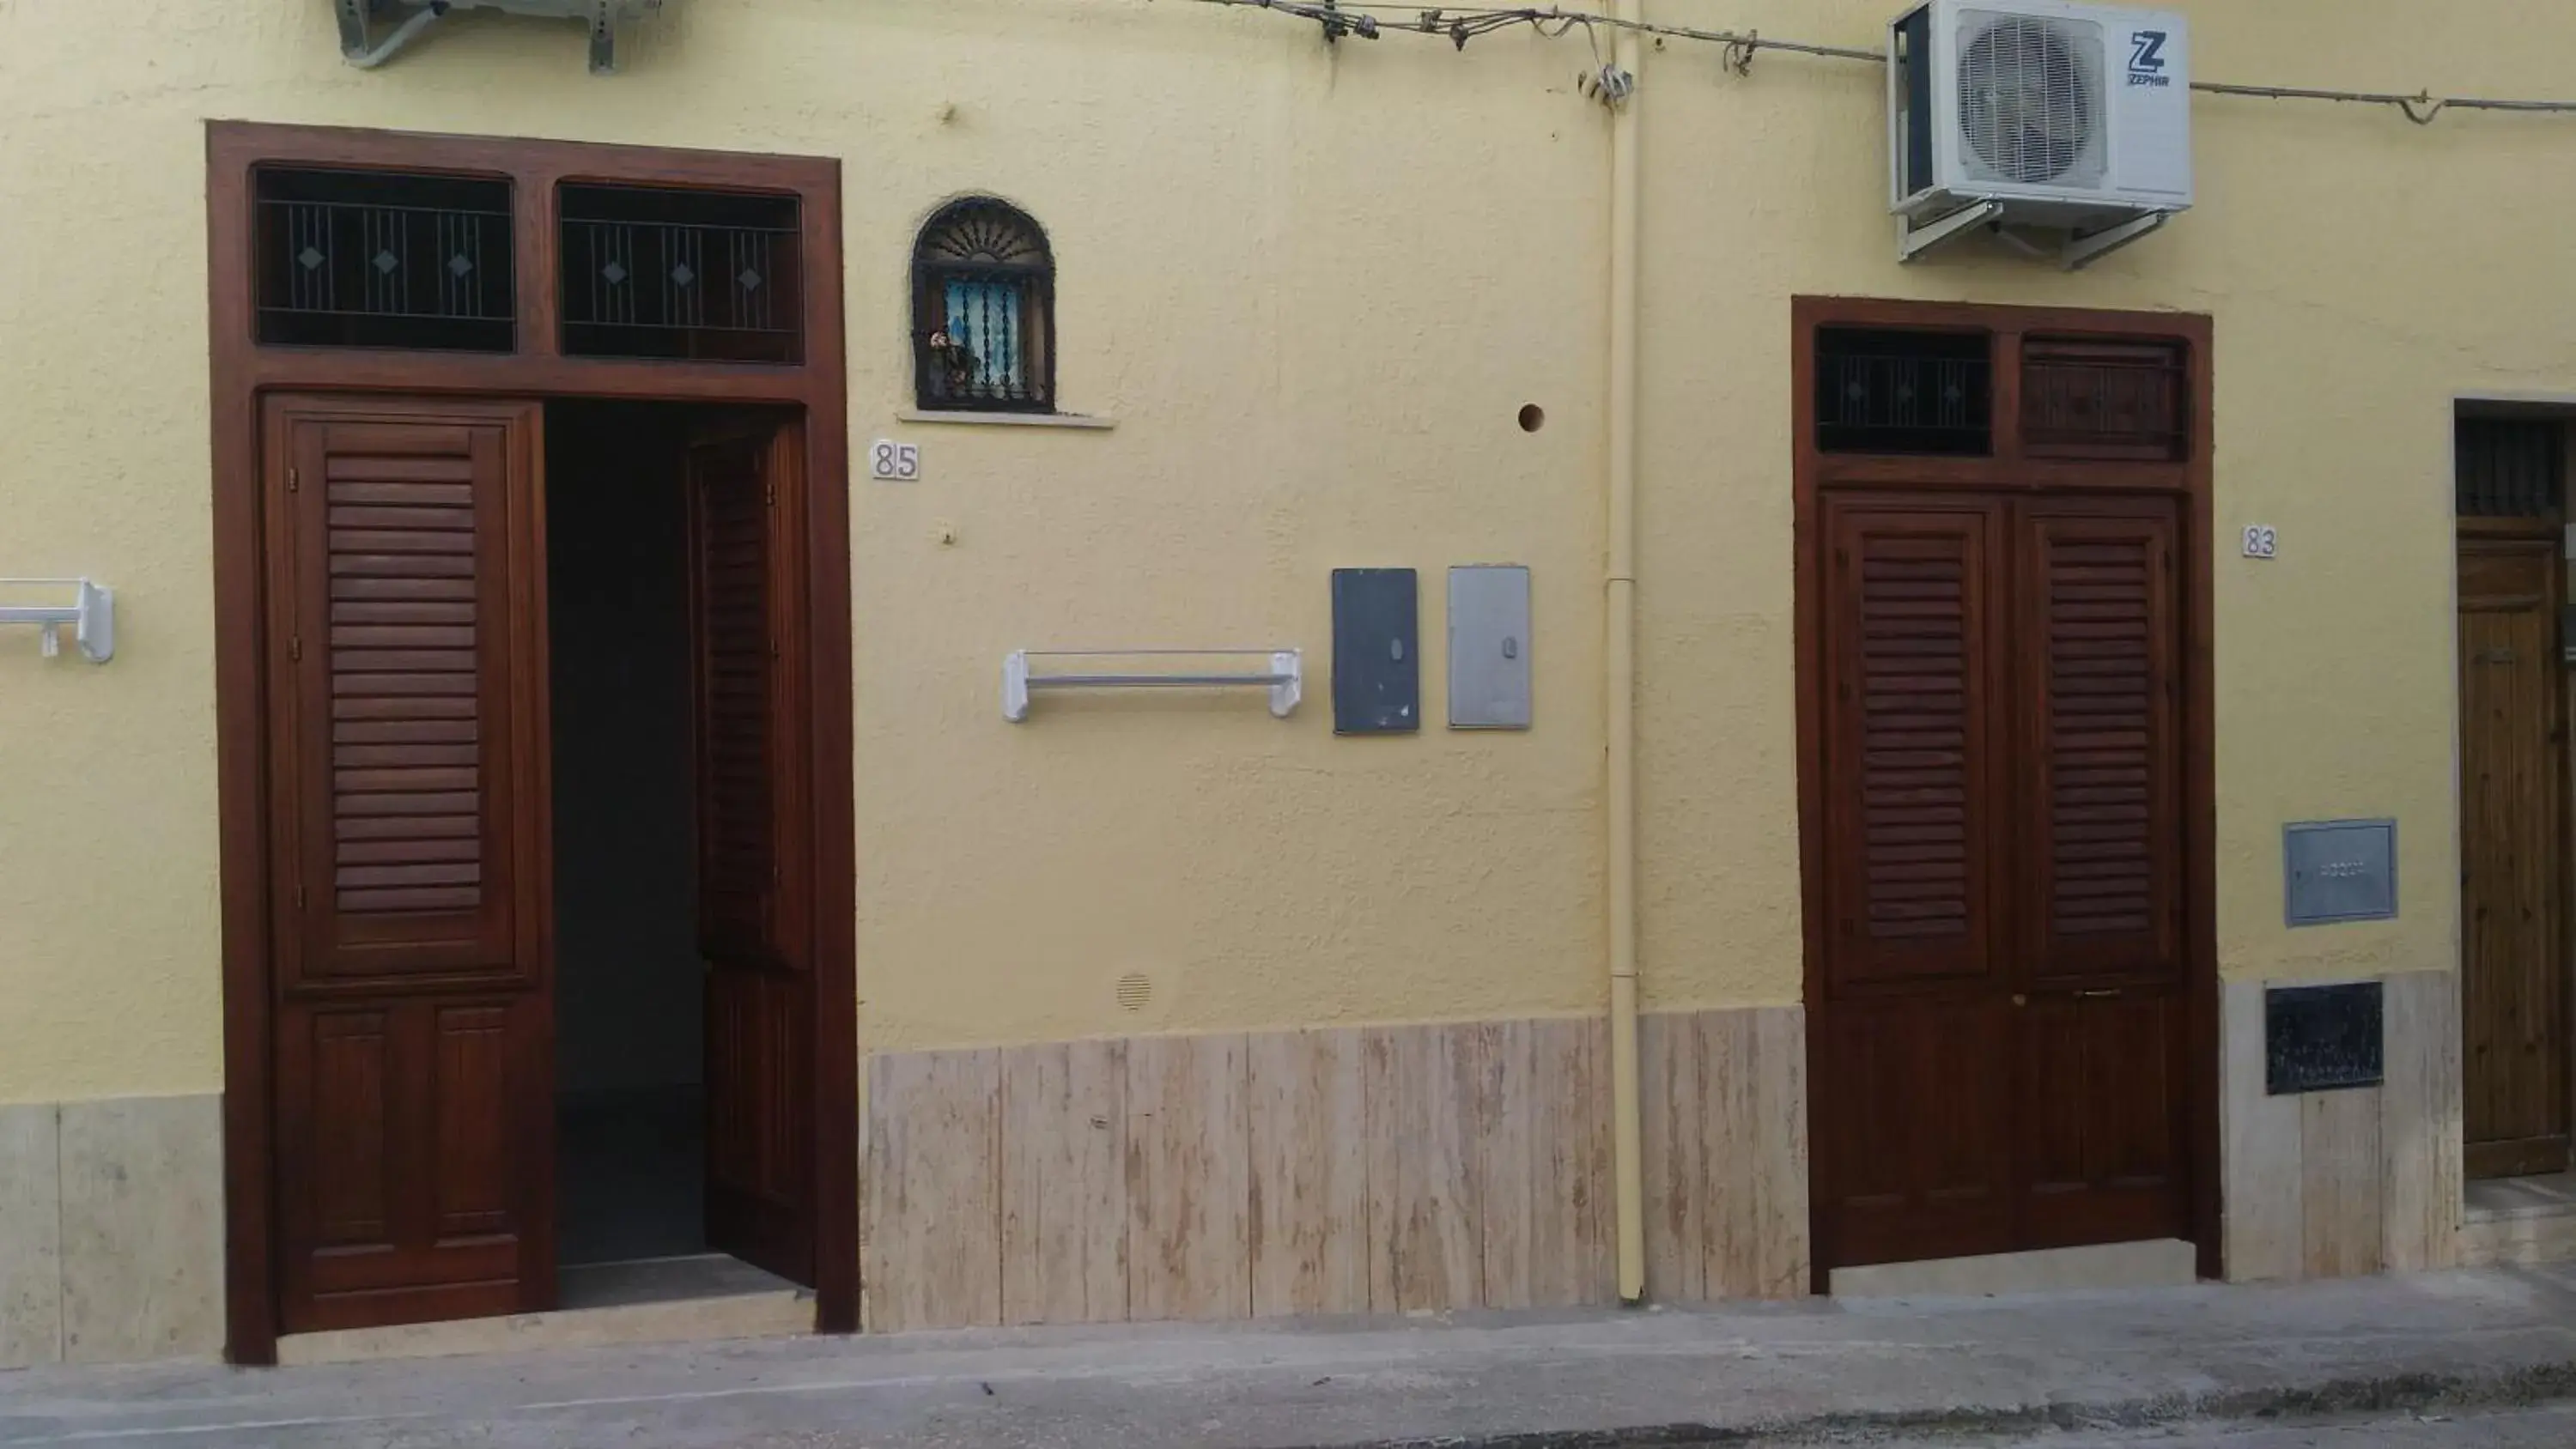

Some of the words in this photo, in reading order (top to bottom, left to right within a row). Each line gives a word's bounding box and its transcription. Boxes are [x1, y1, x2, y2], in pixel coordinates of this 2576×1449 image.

[2129, 74, 2170, 86] ZEPHIR
[876, 444, 916, 476] 85
[2248, 528, 2275, 555] 83
